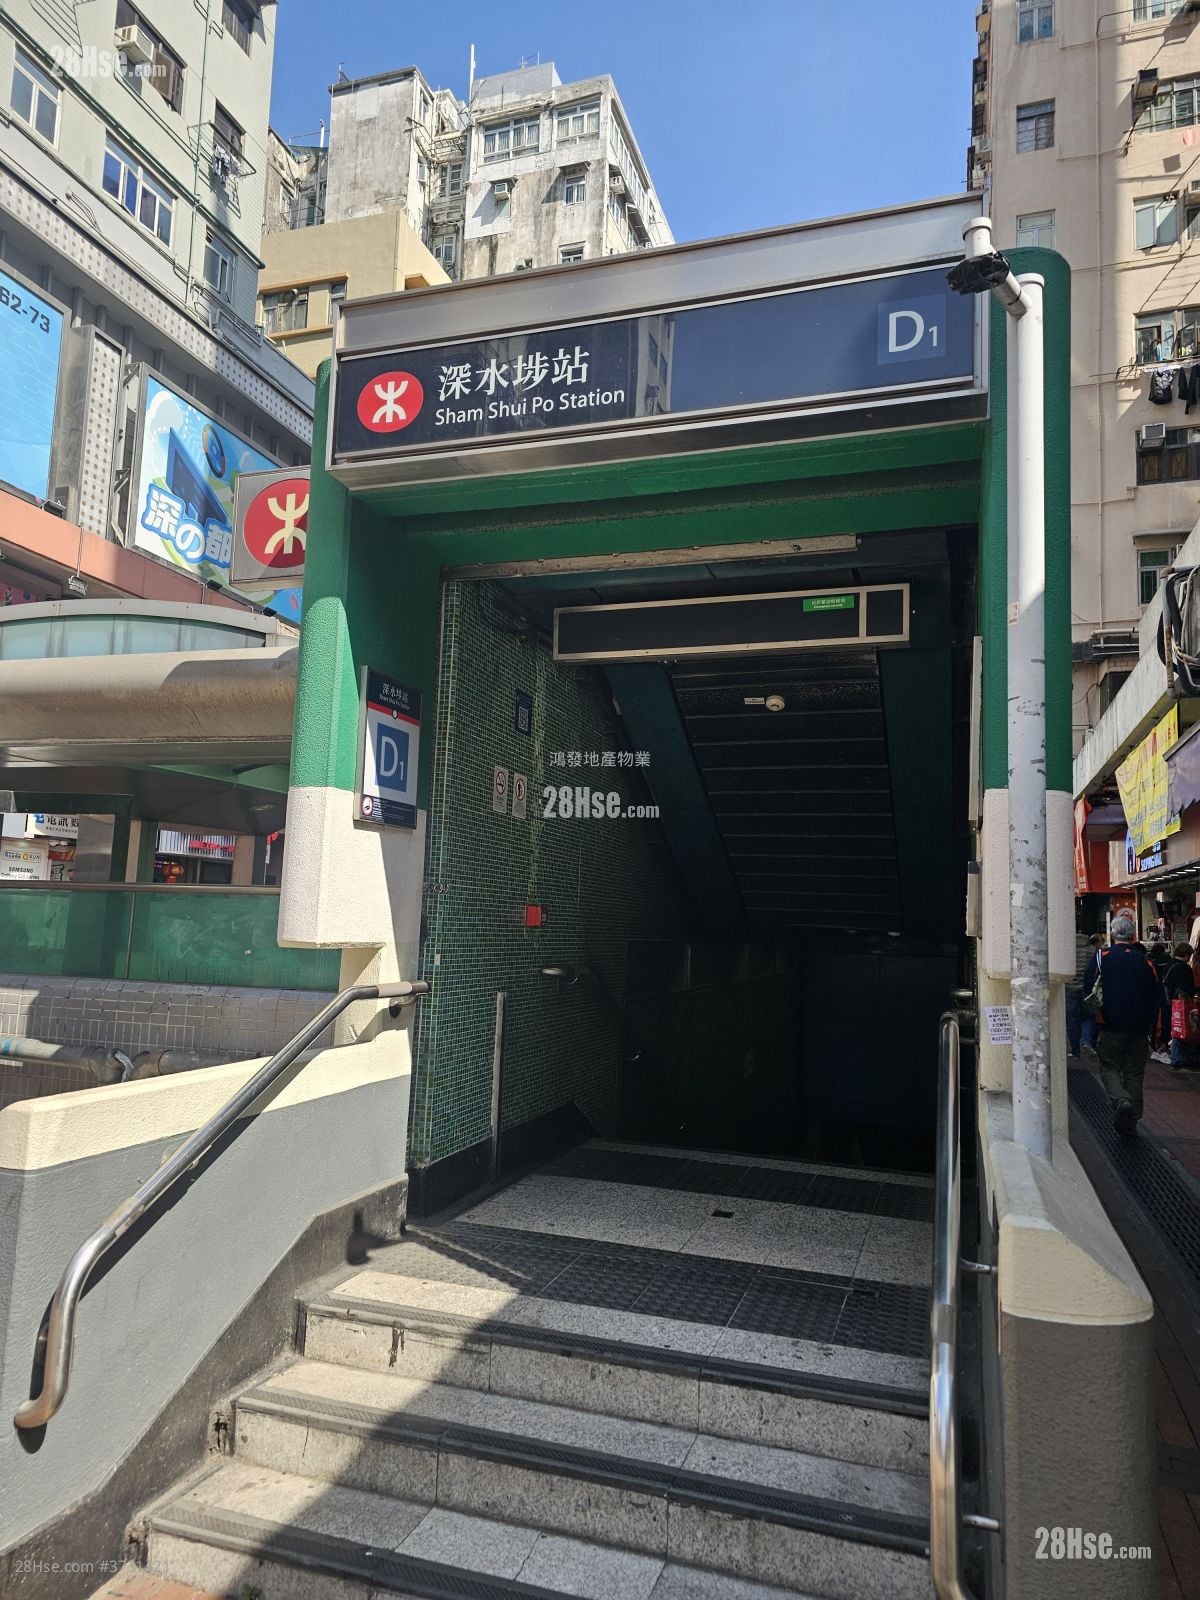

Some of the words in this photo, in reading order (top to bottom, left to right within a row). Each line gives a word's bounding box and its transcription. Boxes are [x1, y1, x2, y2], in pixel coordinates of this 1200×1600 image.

[889, 310, 938, 353] D1
[438, 345, 590, 402] 深水埗站
[435, 406, 484, 426] Sham
[488, 400, 528, 419] Shui
[532, 395, 555, 414] Po
[559, 387, 626, 411] Station
[379, 735, 404, 781] D1
